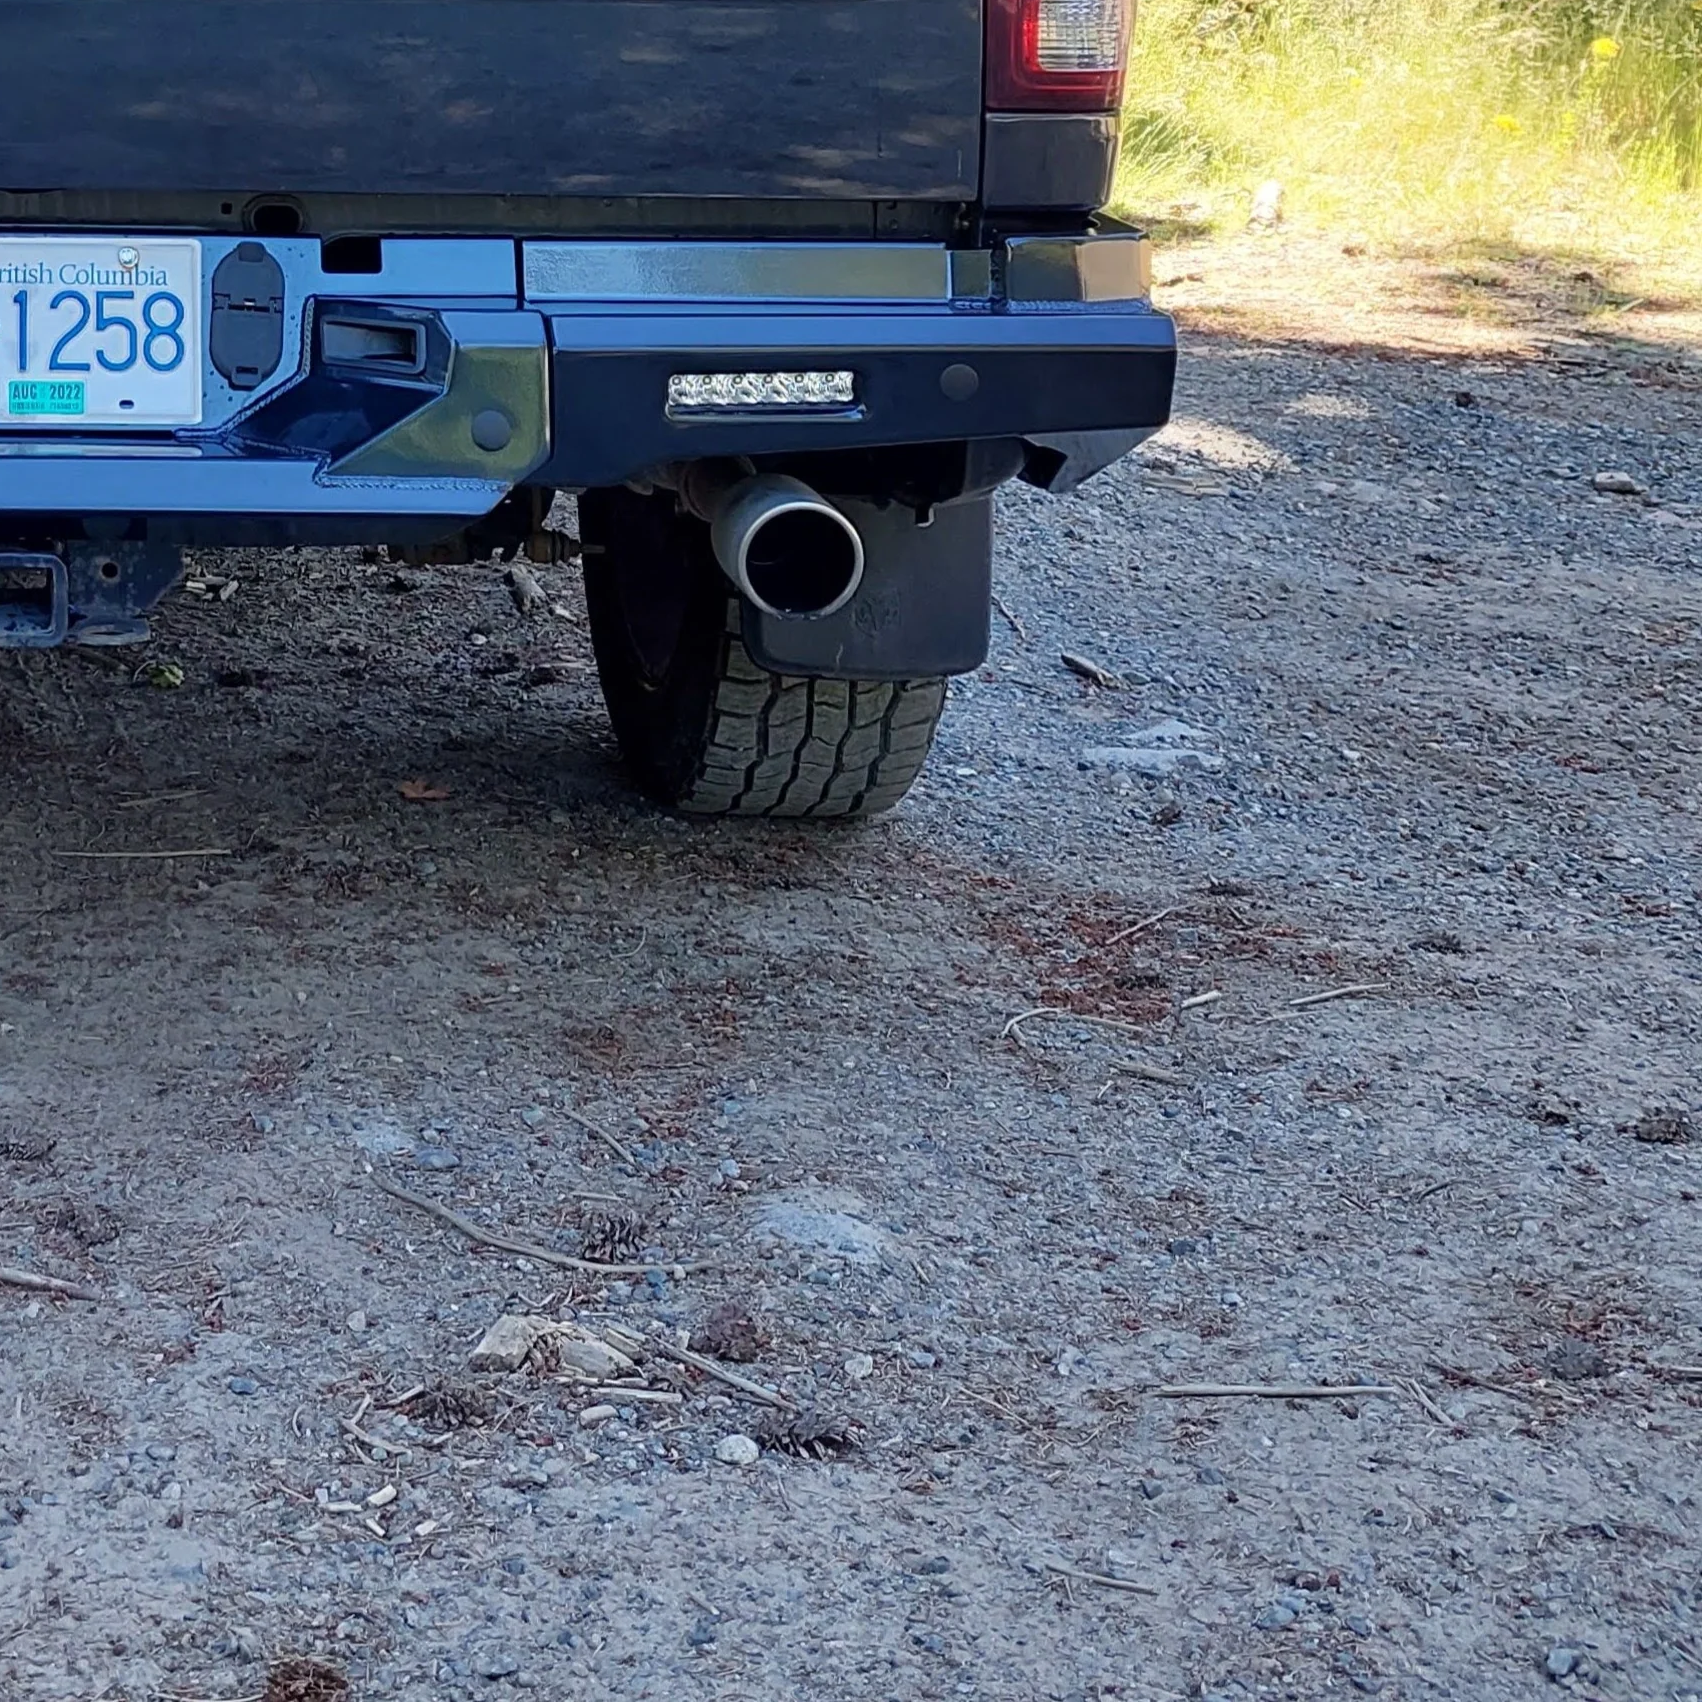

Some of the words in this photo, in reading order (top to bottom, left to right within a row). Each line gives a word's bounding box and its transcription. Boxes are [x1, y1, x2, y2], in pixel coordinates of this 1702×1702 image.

[58, 264, 168, 287] Columbia
[13, 289, 185, 372] 1258
[49, 384, 81, 400] 2022
